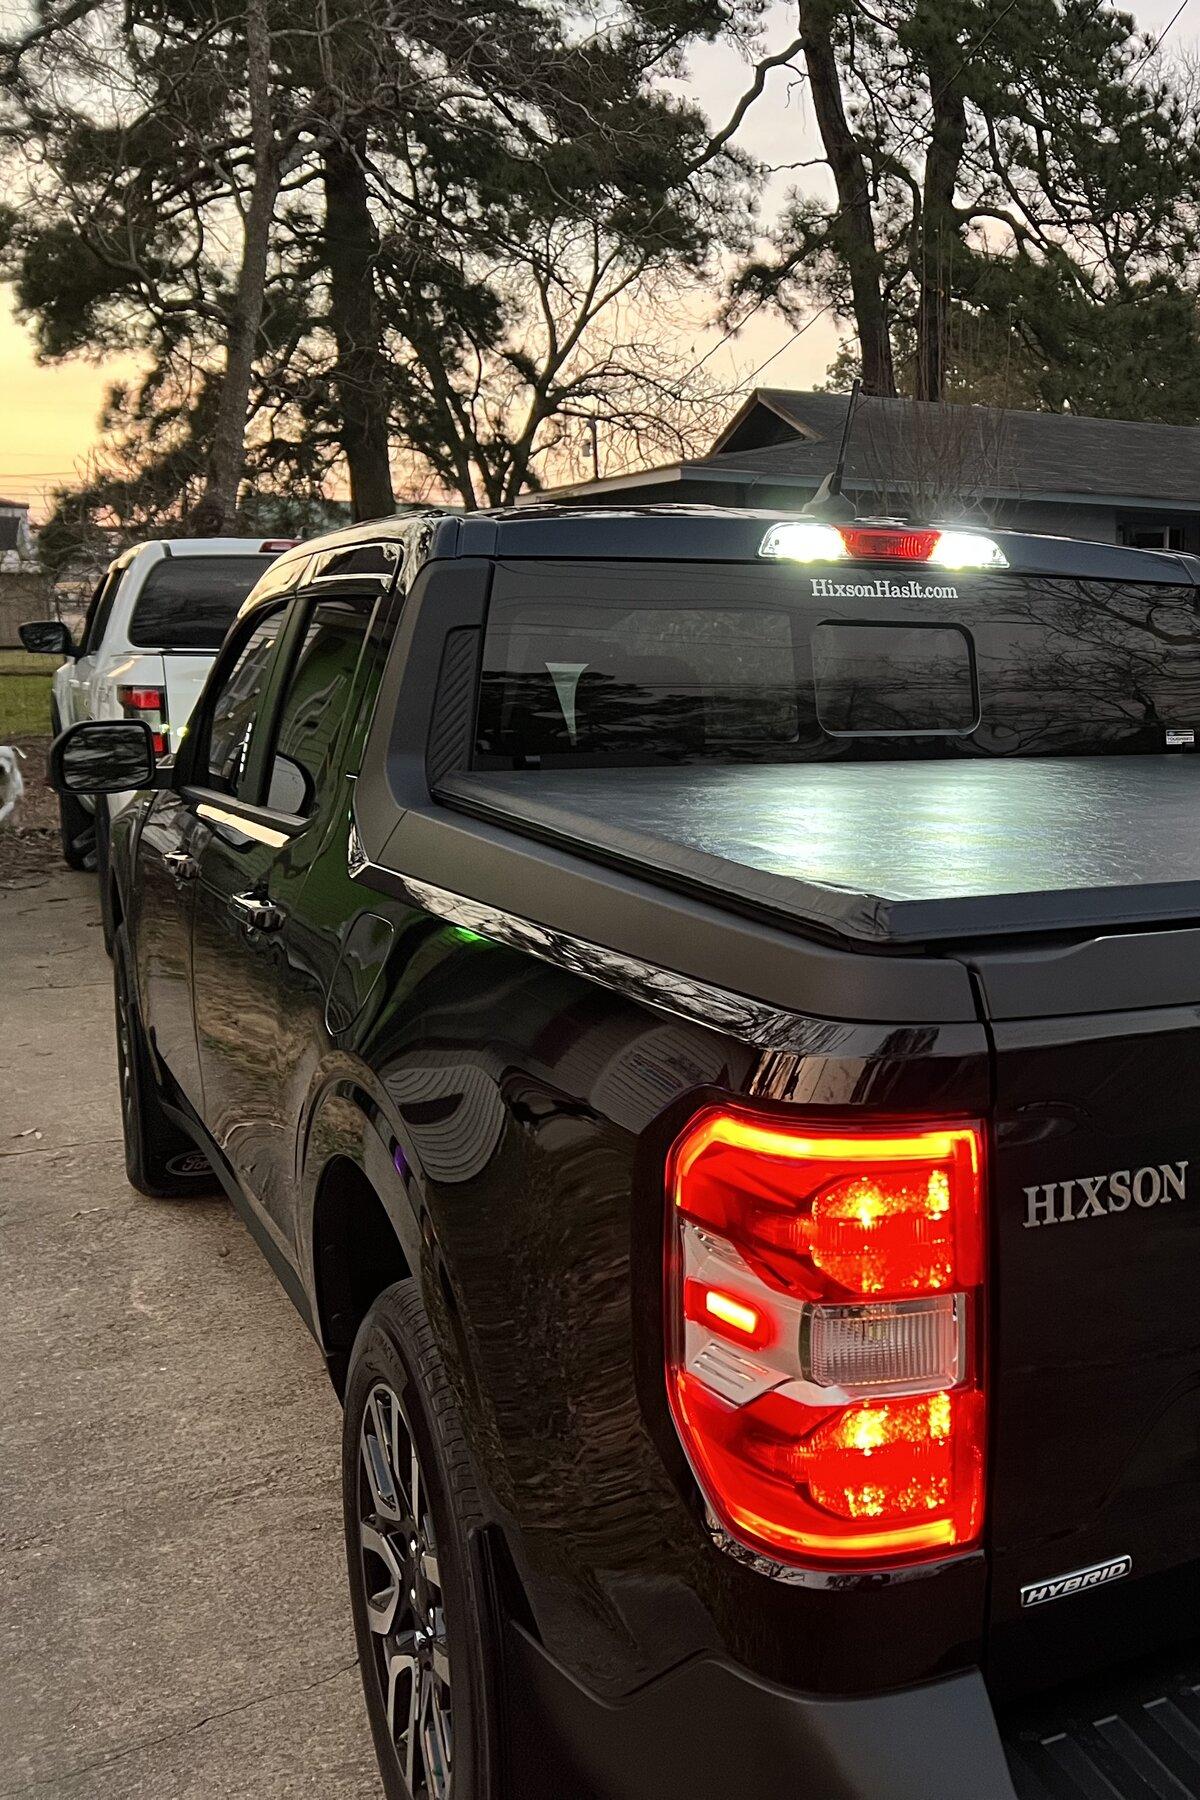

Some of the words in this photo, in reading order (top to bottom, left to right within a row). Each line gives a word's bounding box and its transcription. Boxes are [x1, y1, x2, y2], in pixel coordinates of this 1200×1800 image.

[810, 578, 958, 599] HixsonHasIt.com
[1022, 1161, 1189, 1228] HIXSON
[1027, 1562, 1126, 1603] HYBRID
